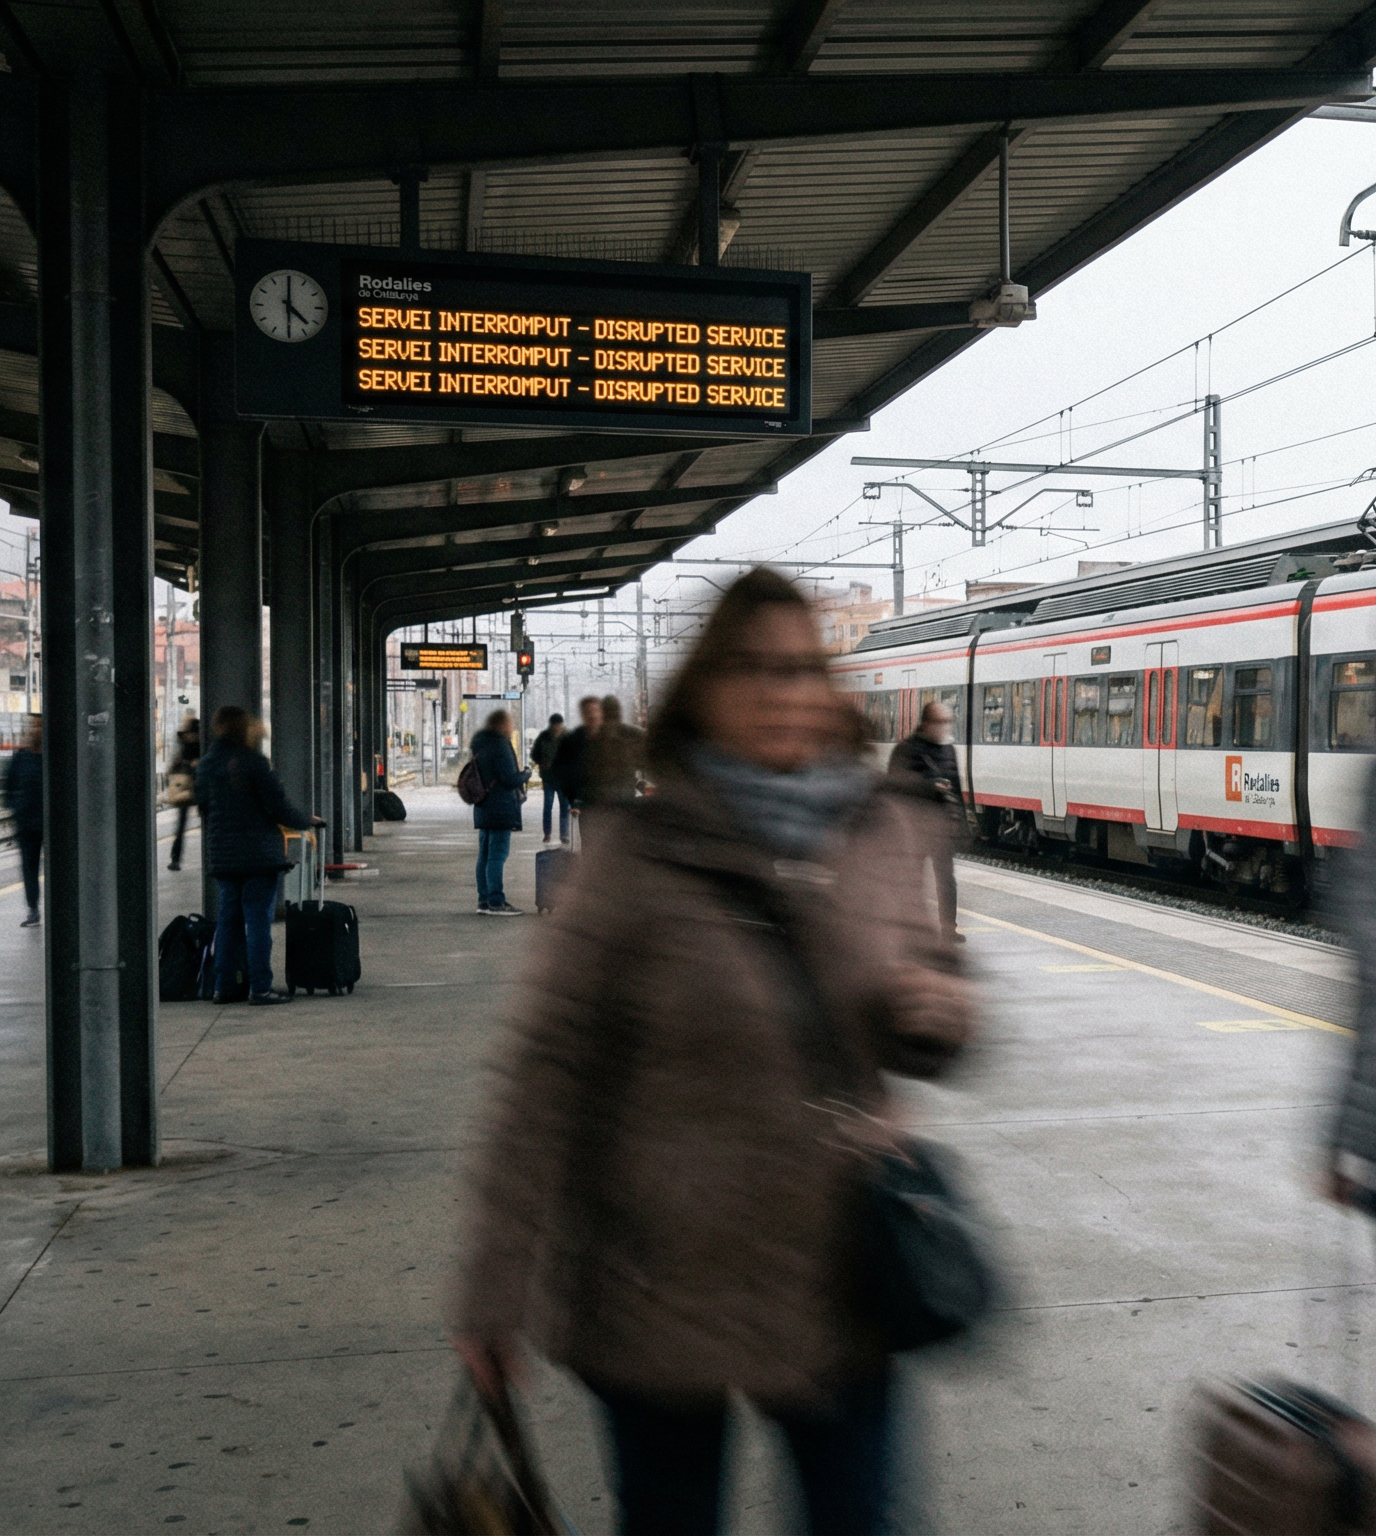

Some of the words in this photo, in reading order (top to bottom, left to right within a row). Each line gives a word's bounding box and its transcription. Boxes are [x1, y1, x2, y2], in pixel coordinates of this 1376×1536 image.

[359, 274, 432, 292] Rodalies
[358, 307, 432, 330] SERVEI
[438, 311, 572, 337] INTERROMPUT
[594, 319, 701, 344] DISRUPTED
[706, 325, 786, 348] SERVICE
[358, 338, 432, 360] SERVEI
[438, 342, 572, 368] INTERROMPUT
[594, 350, 701, 374] DISRUPTED
[706, 356, 786, 378] SERVICE
[358, 368, 432, 391] SERVEI
[438, 372, 572, 398] INTERROMPUT
[594, 380, 701, 405] DISRUPTED
[706, 386, 786, 409] SERVICE
[1231, 763, 1241, 792] R
